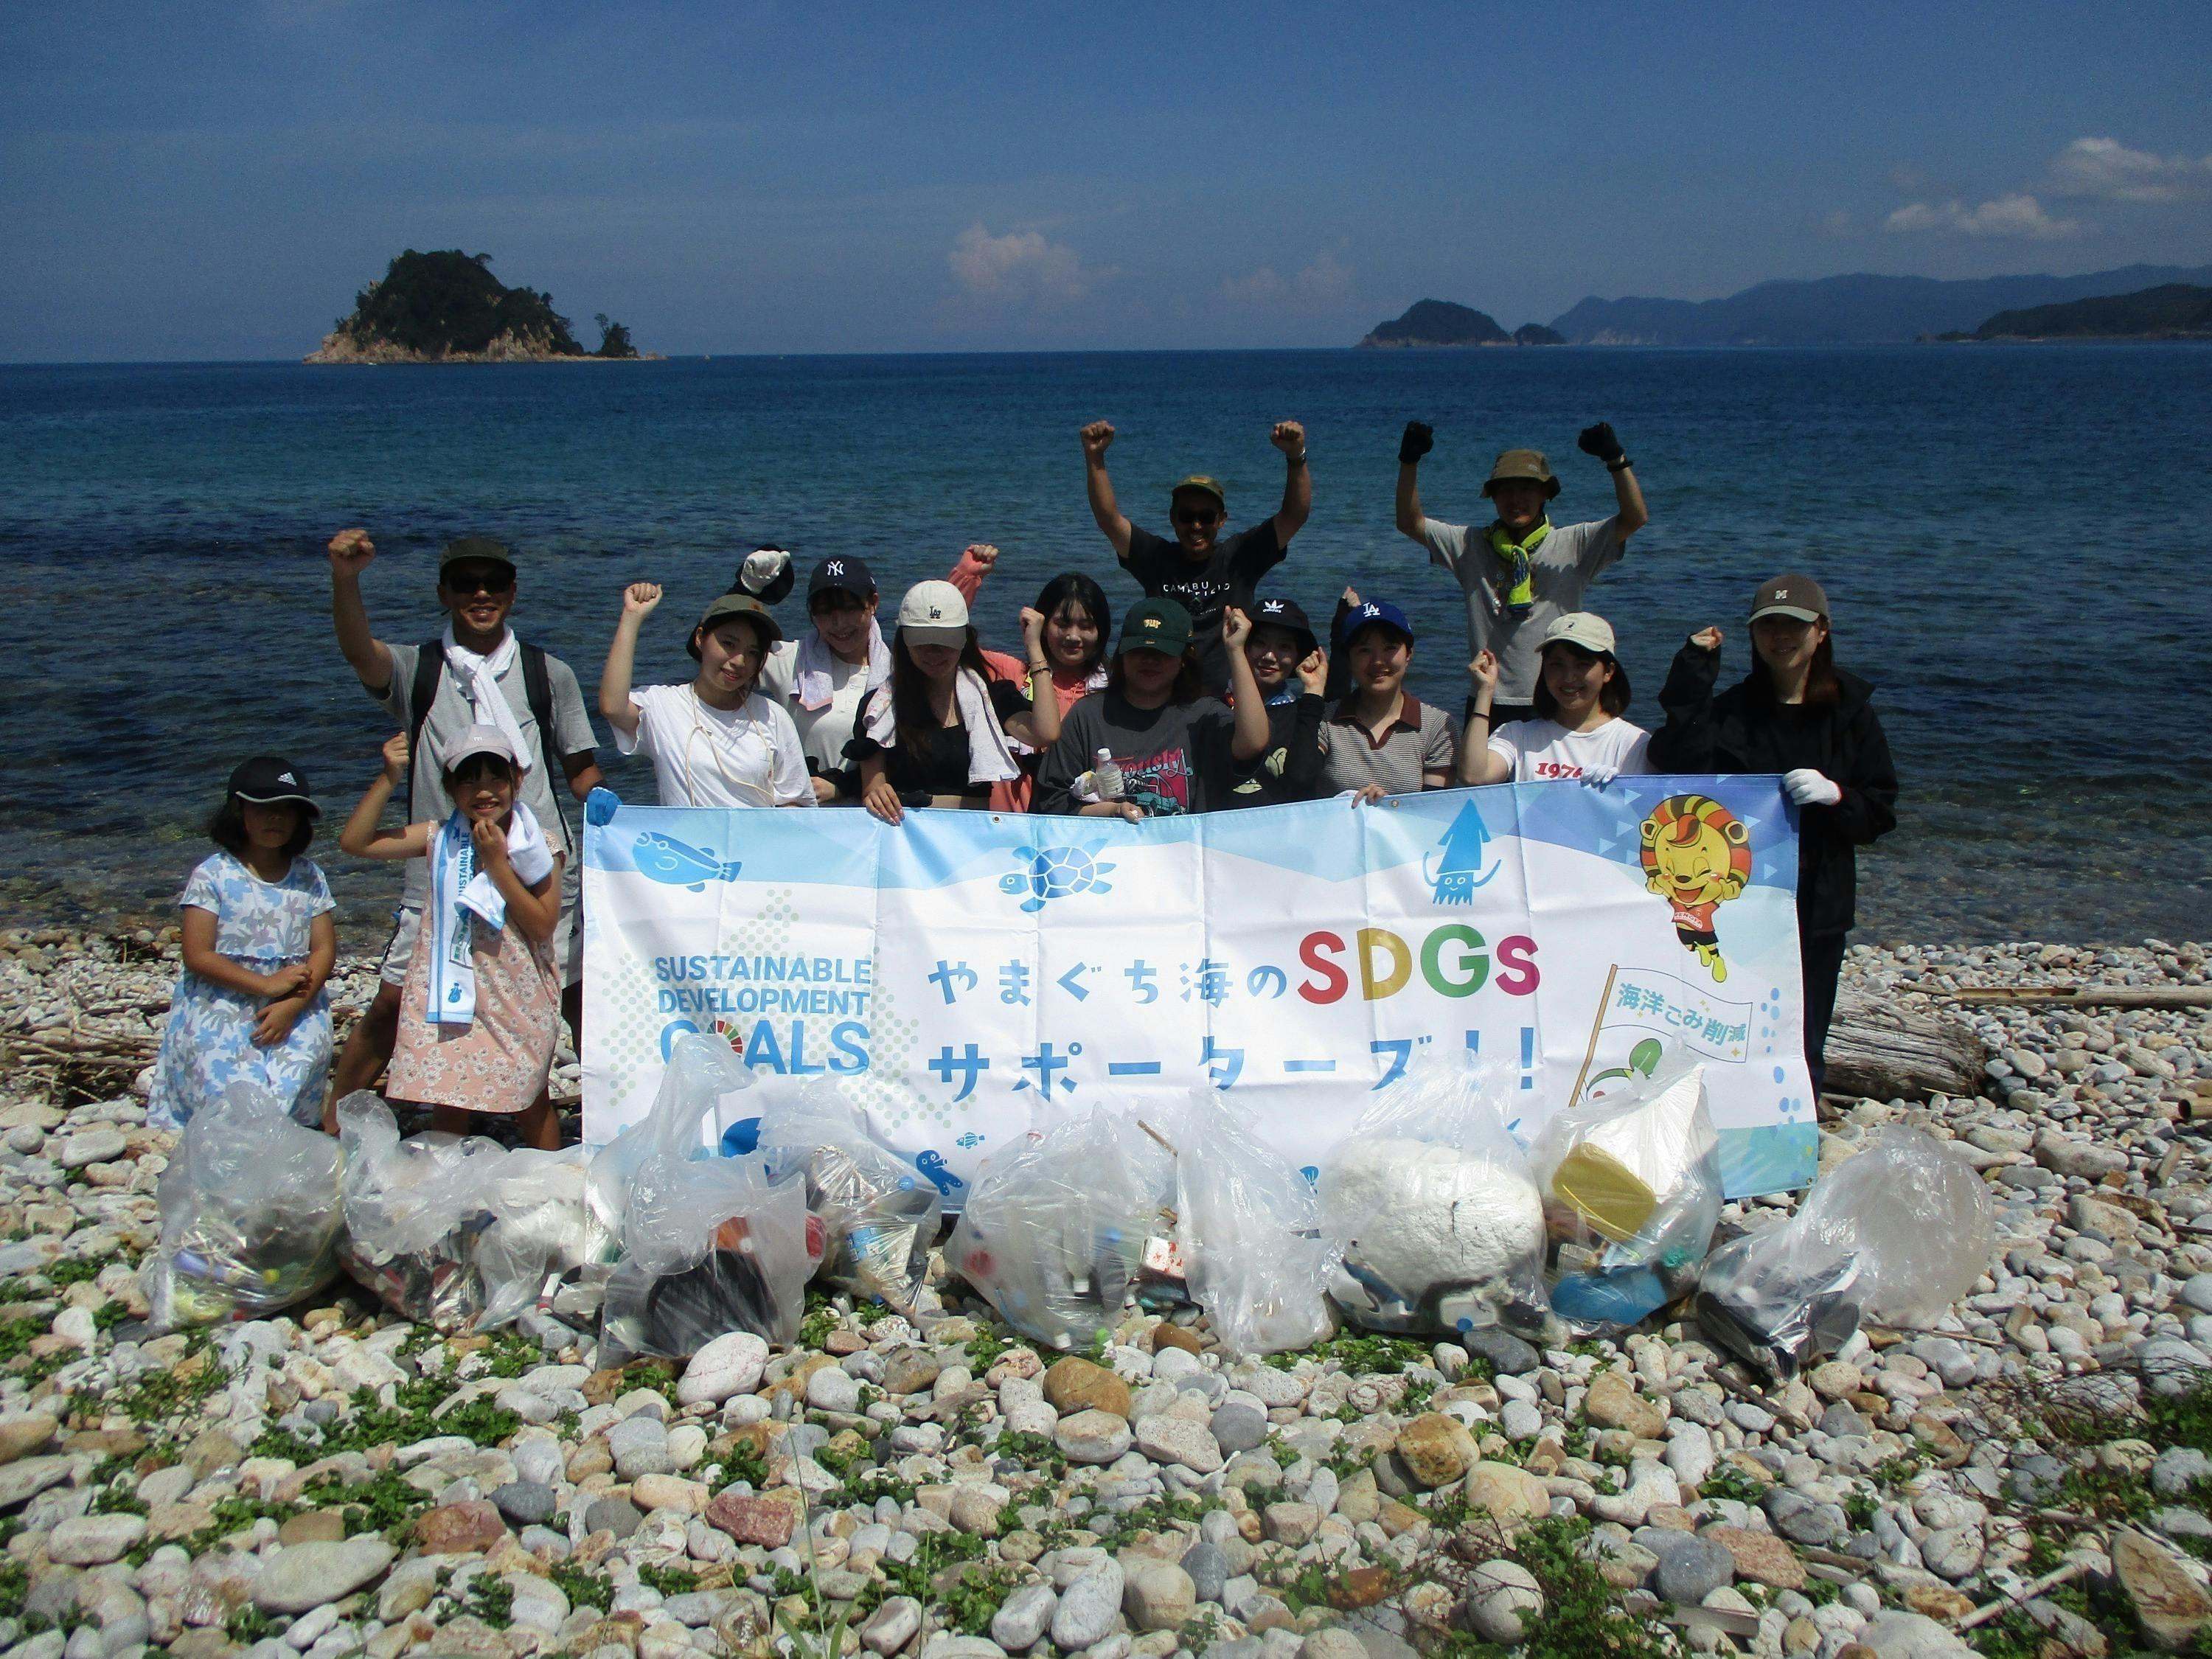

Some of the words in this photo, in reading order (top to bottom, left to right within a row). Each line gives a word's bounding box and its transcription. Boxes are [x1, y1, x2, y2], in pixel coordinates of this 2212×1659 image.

[827, 560, 844, 576] NY
[1363, 602, 1381, 617] LA
[655, 955, 872, 984] SUSTAINABLE
[658, 987, 871, 1016] DEVELOPMENT
